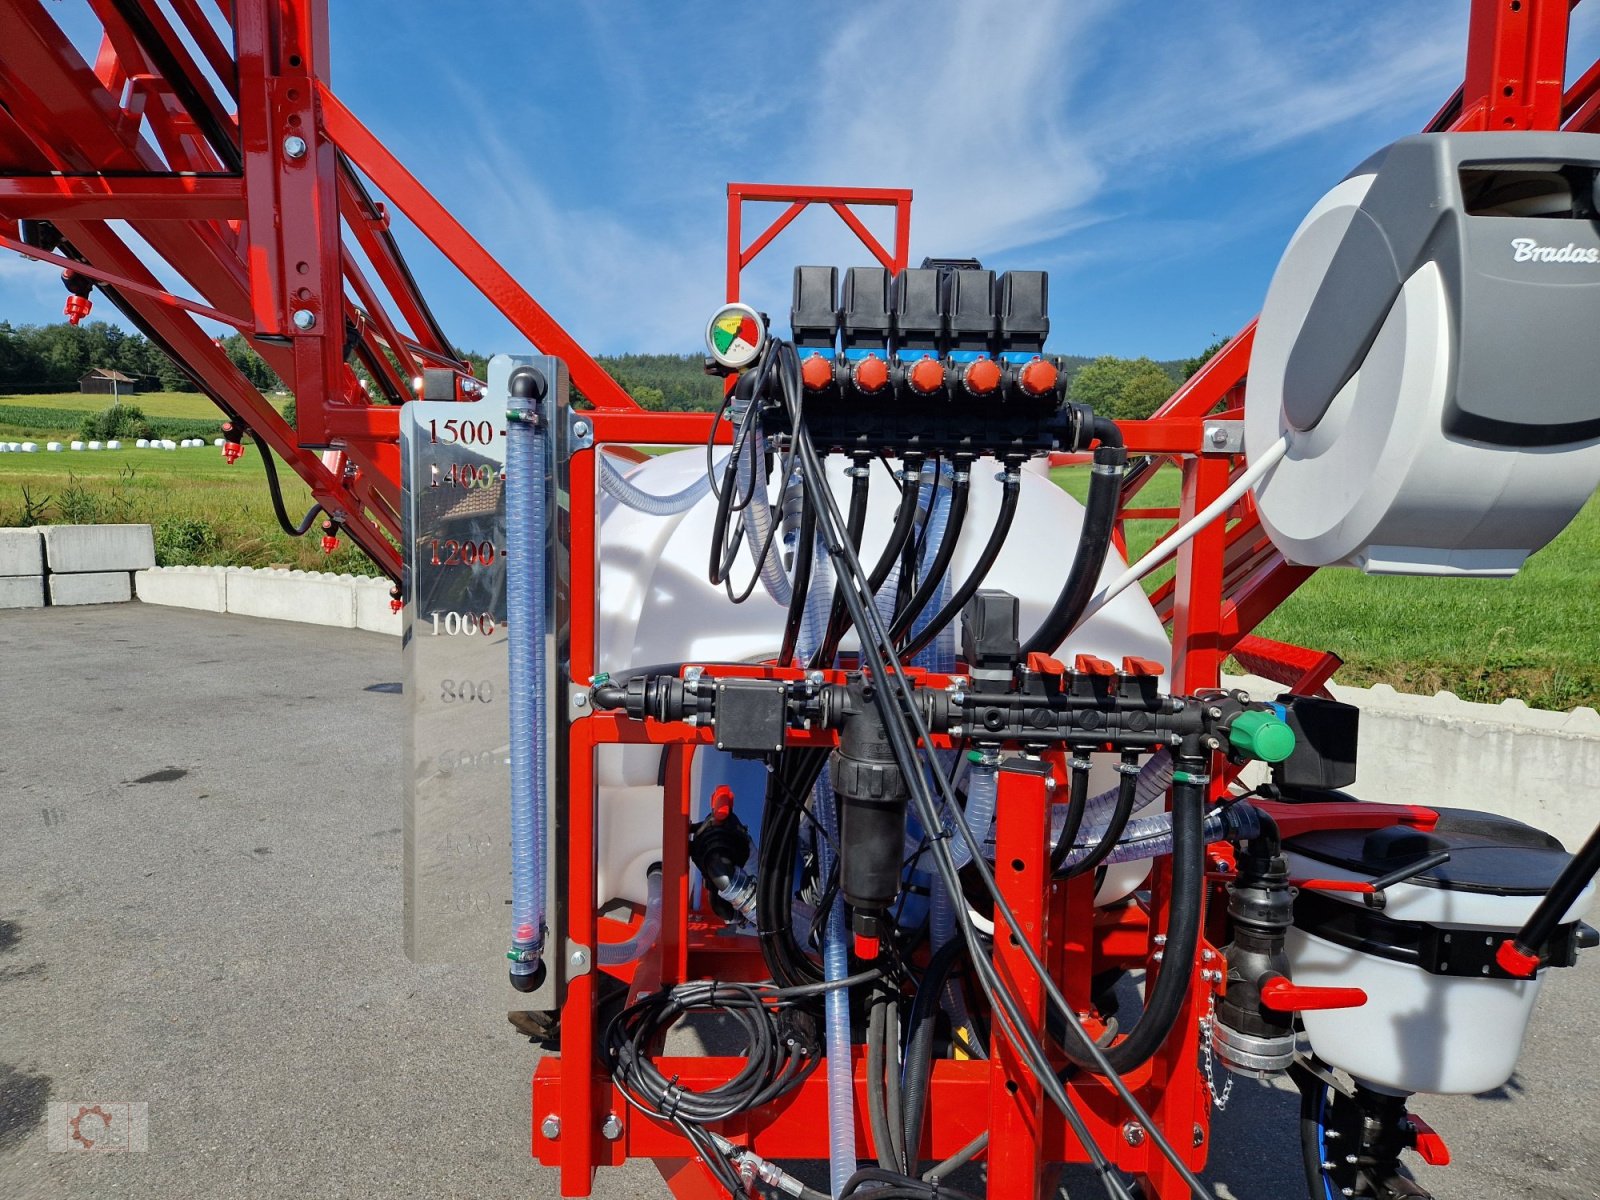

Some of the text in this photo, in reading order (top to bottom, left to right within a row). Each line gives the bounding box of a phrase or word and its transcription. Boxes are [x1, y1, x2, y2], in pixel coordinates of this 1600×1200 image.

[429, 419, 493, 445] 1500
[430, 463, 494, 489] 1400
[430, 539, 494, 566] 1200
[430, 611, 495, 636] 1000
[441, 679, 494, 703] 800
